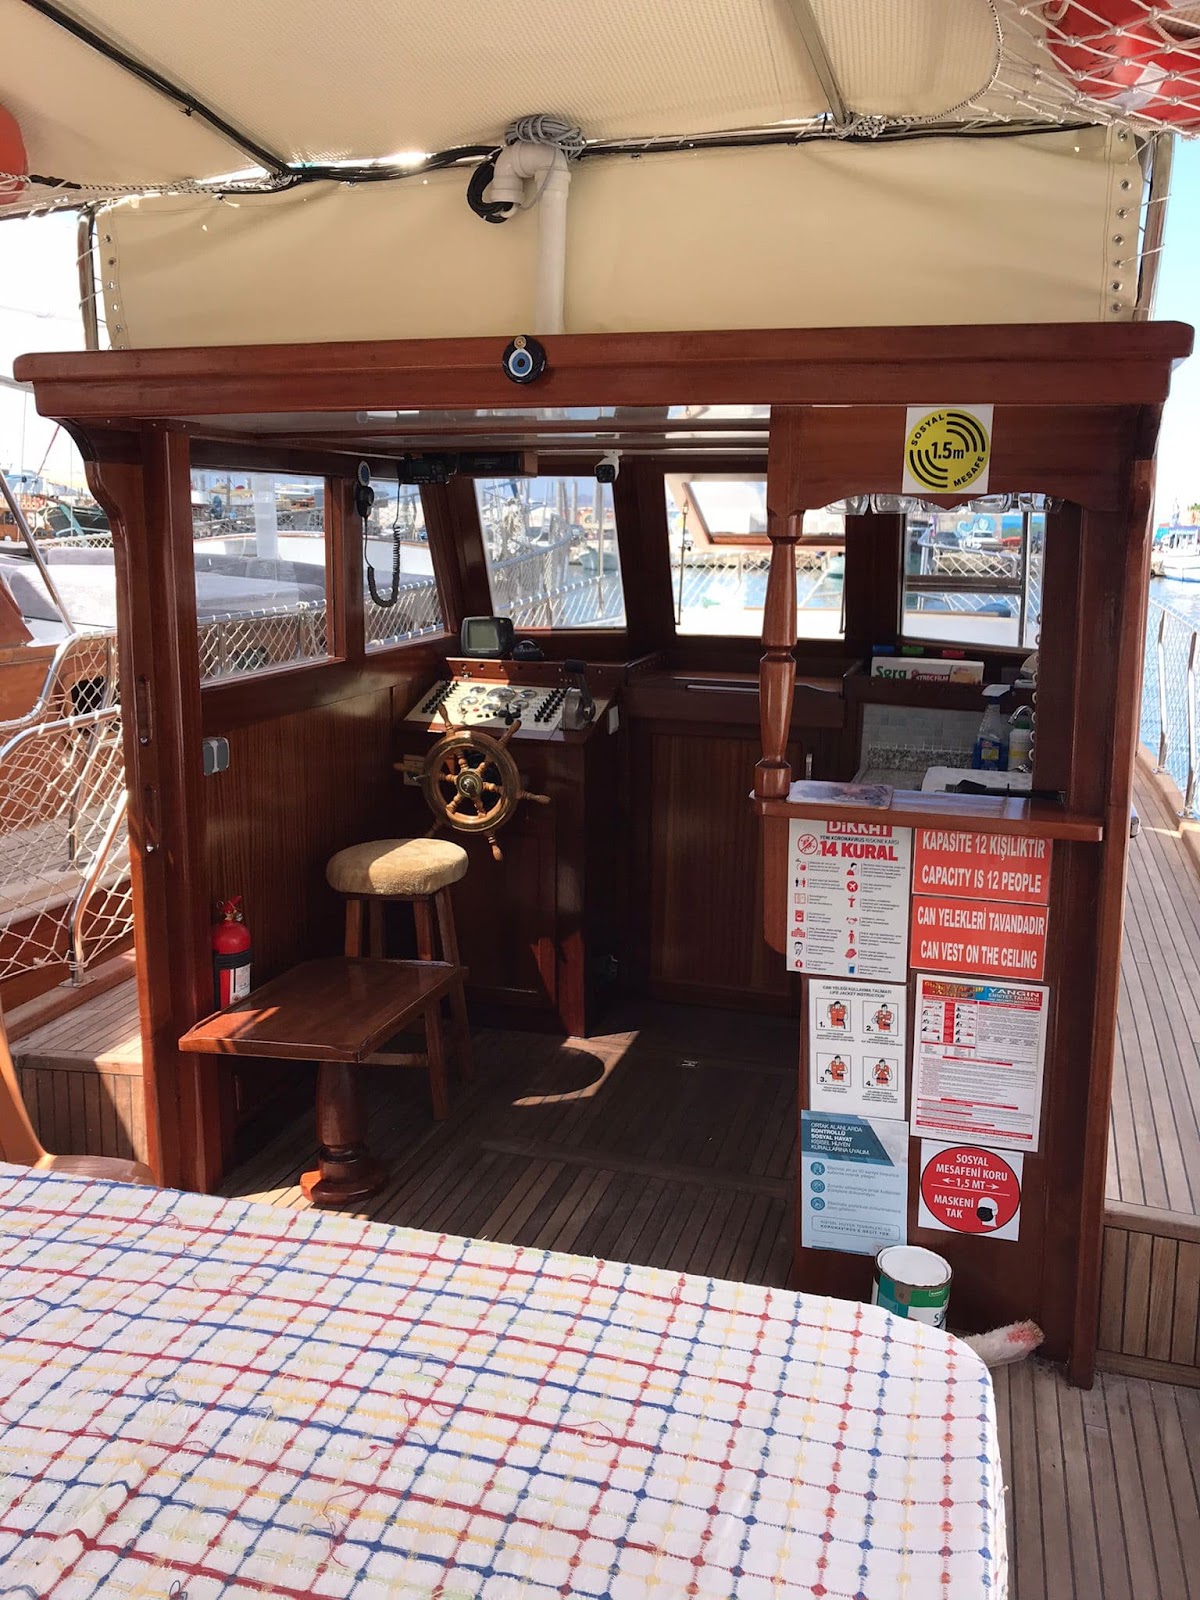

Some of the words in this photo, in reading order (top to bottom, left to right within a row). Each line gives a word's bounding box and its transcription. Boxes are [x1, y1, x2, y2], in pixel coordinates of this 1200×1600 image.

[911, 414, 944, 446] SOSYAL
[931, 442, 964, 459] 1.5m
[953, 456, 984, 487] MESAFE
[876, 666, 907, 679] Sera
[841, 842, 899, 861] KURAL
[922, 831, 972, 853] KAPASİTE
[975, 834, 986, 854] 12
[989, 834, 1045, 860] KİŞİLİKTİR
[922, 864, 972, 887] CAPACITY
[974, 869, 984, 889] IS
[987, 870, 999, 890] 12
[1001, 872, 1042, 893] PEOPLE
[917, 906, 936, 926] CAN
[938, 907, 987, 930] YELEKLERİ
[989, 912, 1045, 936] TAVANDADIR
[920, 940, 939, 959] CAN
[941, 942, 964, 962] VEST
[965, 944, 979, 963] ON
[981, 946, 999, 965] THE
[1001, 948, 1037, 969] CEILING
[989, 987, 1040, 998] YANGIN
[811, 1133, 833, 1141] SOSYAL
[956, 1154, 989, 1167] SOSYAL
[936, 1163, 980, 1178] MESAFENİ
[983, 1169, 1008, 1181] KORU
[956, 1178, 970, 1188] 1,5
[971, 1180, 986, 1190] MT
[933, 1194, 974, 1208] MASKENİ
[945, 1207, 963, 1219] TAK
